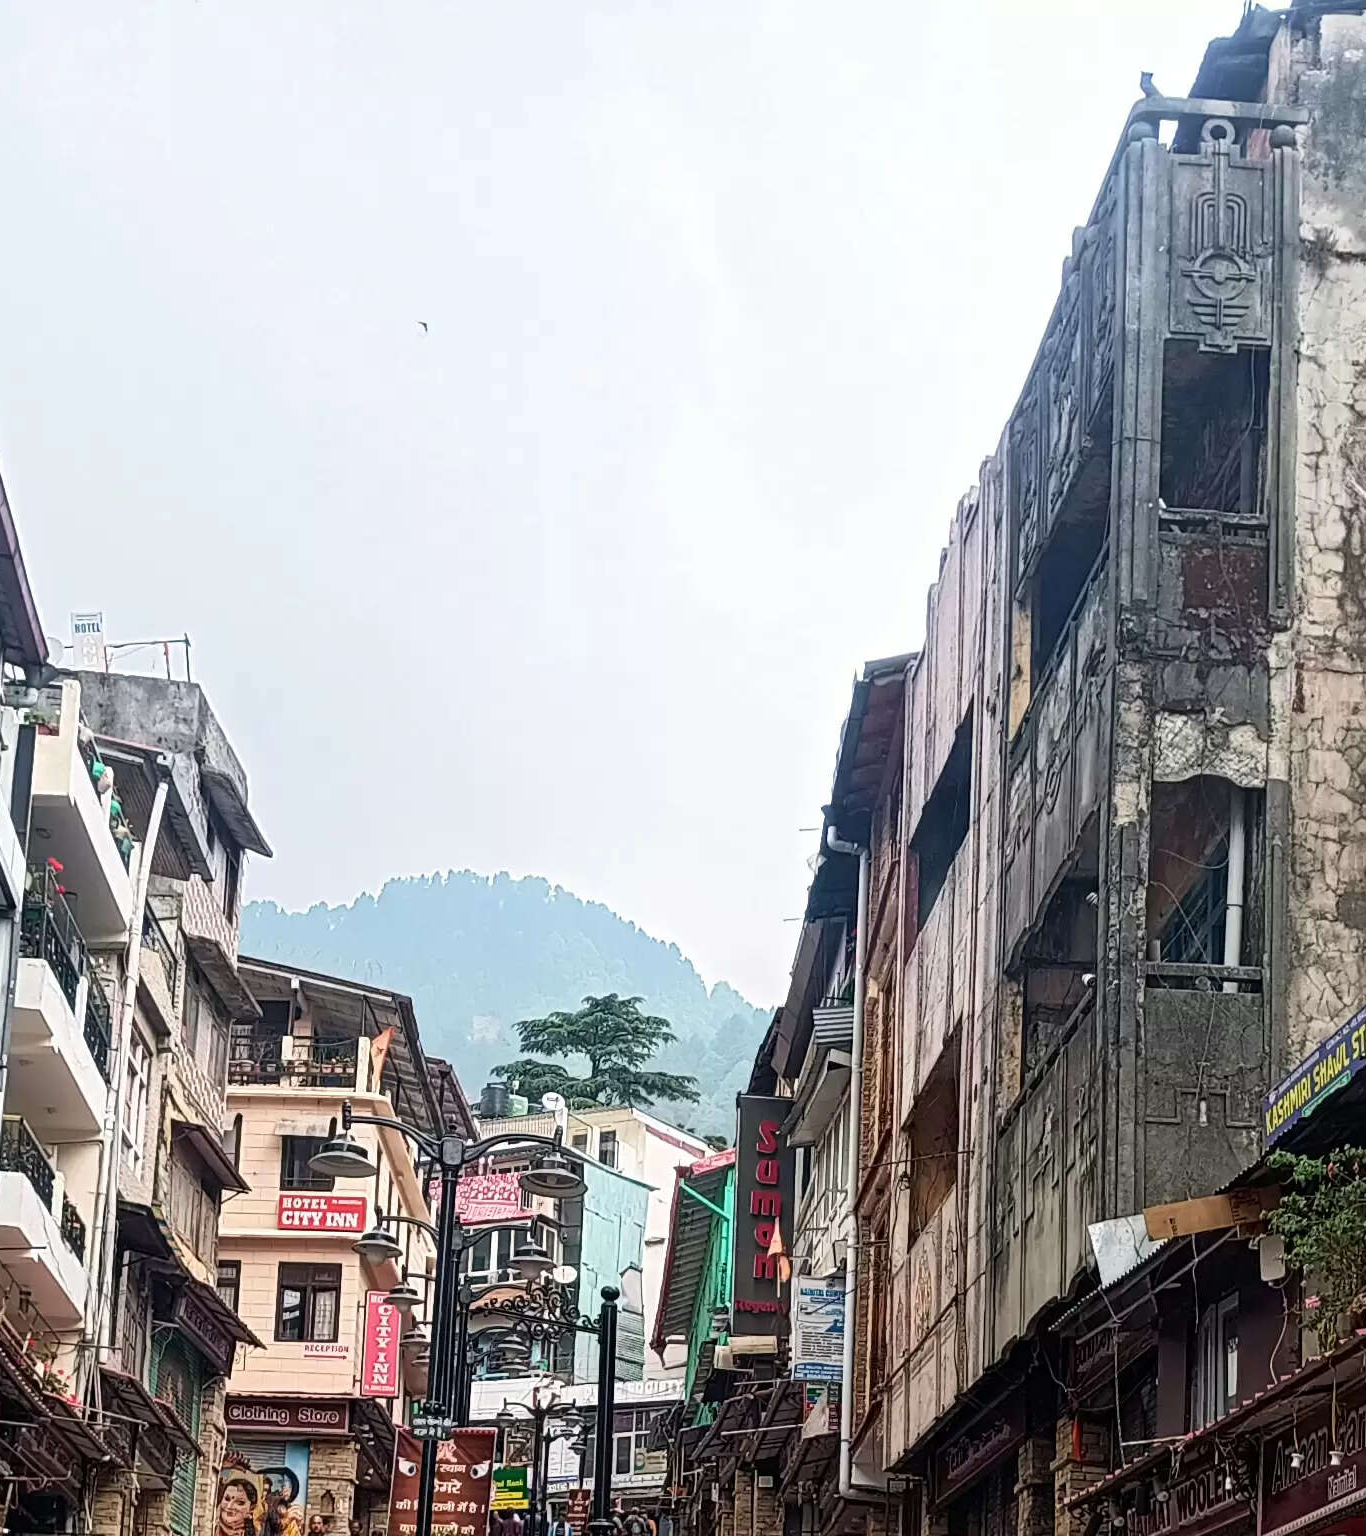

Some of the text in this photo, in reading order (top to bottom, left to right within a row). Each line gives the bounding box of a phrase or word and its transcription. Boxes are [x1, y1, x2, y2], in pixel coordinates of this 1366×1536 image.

[75, 622, 101, 633] HOTEL
[1265, 1073, 1311, 1136] KASHMIRI
[1312, 1043, 1350, 1092] SHAWL
[282, 1197, 327, 1210] HOTEL
[281, 1210, 359, 1228] CITY INN
[375, 1304, 393, 1349] CITY
[372, 1351, 390, 1385] INN
[228, 1404, 340, 1425] Clothing Store
